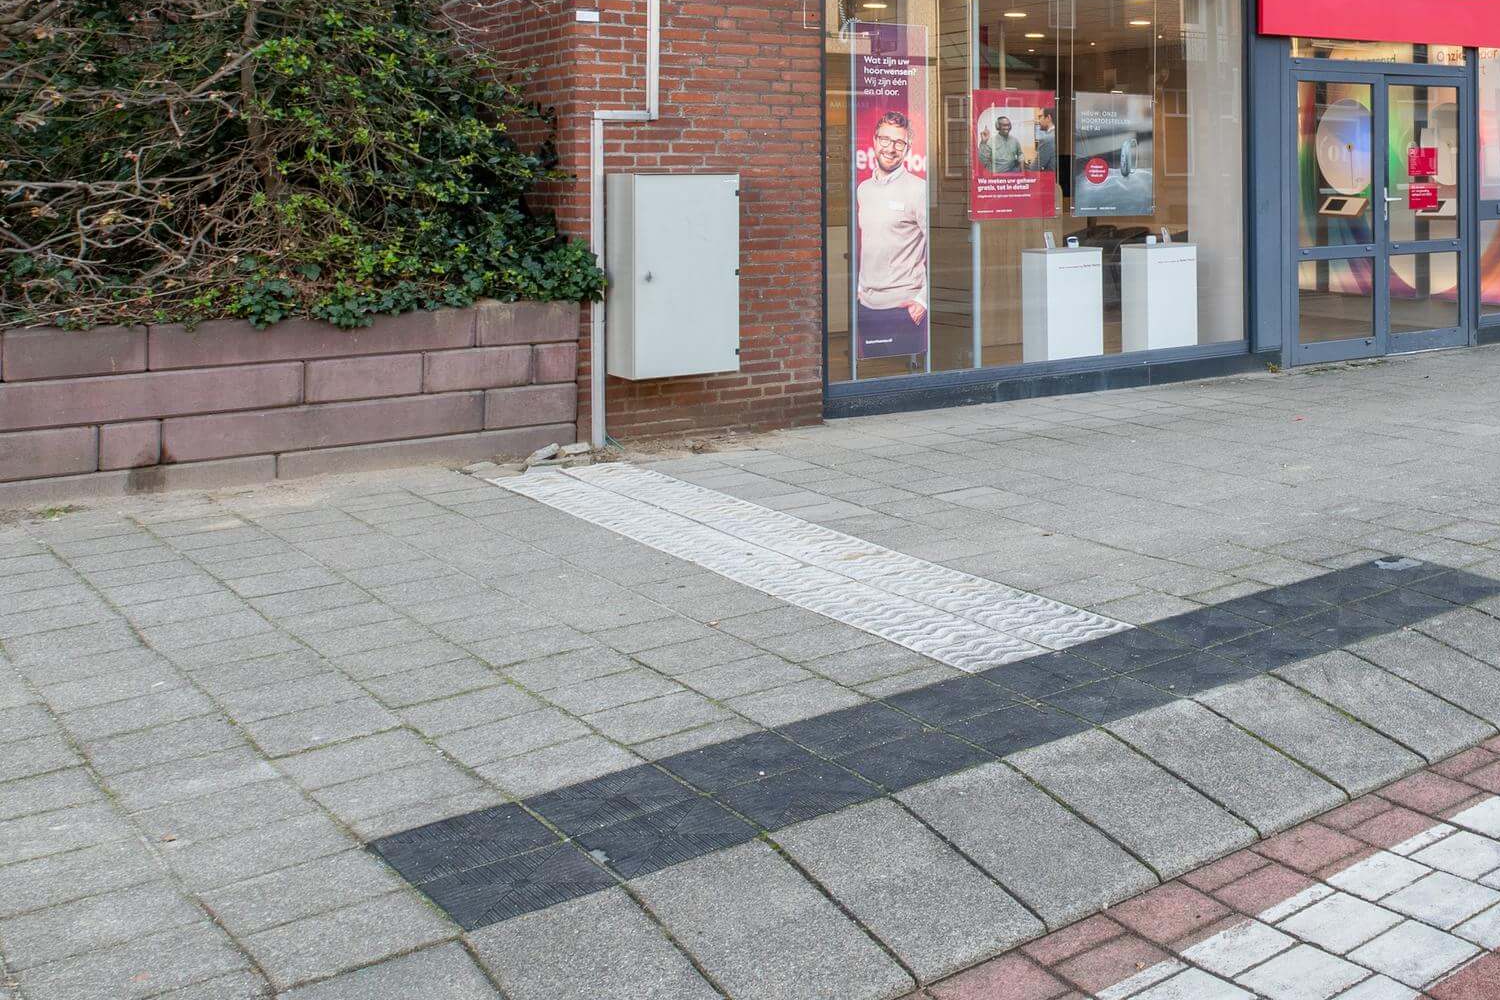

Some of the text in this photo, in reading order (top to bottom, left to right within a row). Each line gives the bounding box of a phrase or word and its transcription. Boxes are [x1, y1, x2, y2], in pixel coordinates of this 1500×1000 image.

[864, 56, 881, 65] Wat
[883, 56, 897, 67] zijn
[864, 66, 917, 76] hoorwensen?
[864, 77, 907, 87] Wij zijn één
[885, 88, 900, 96] oor.
